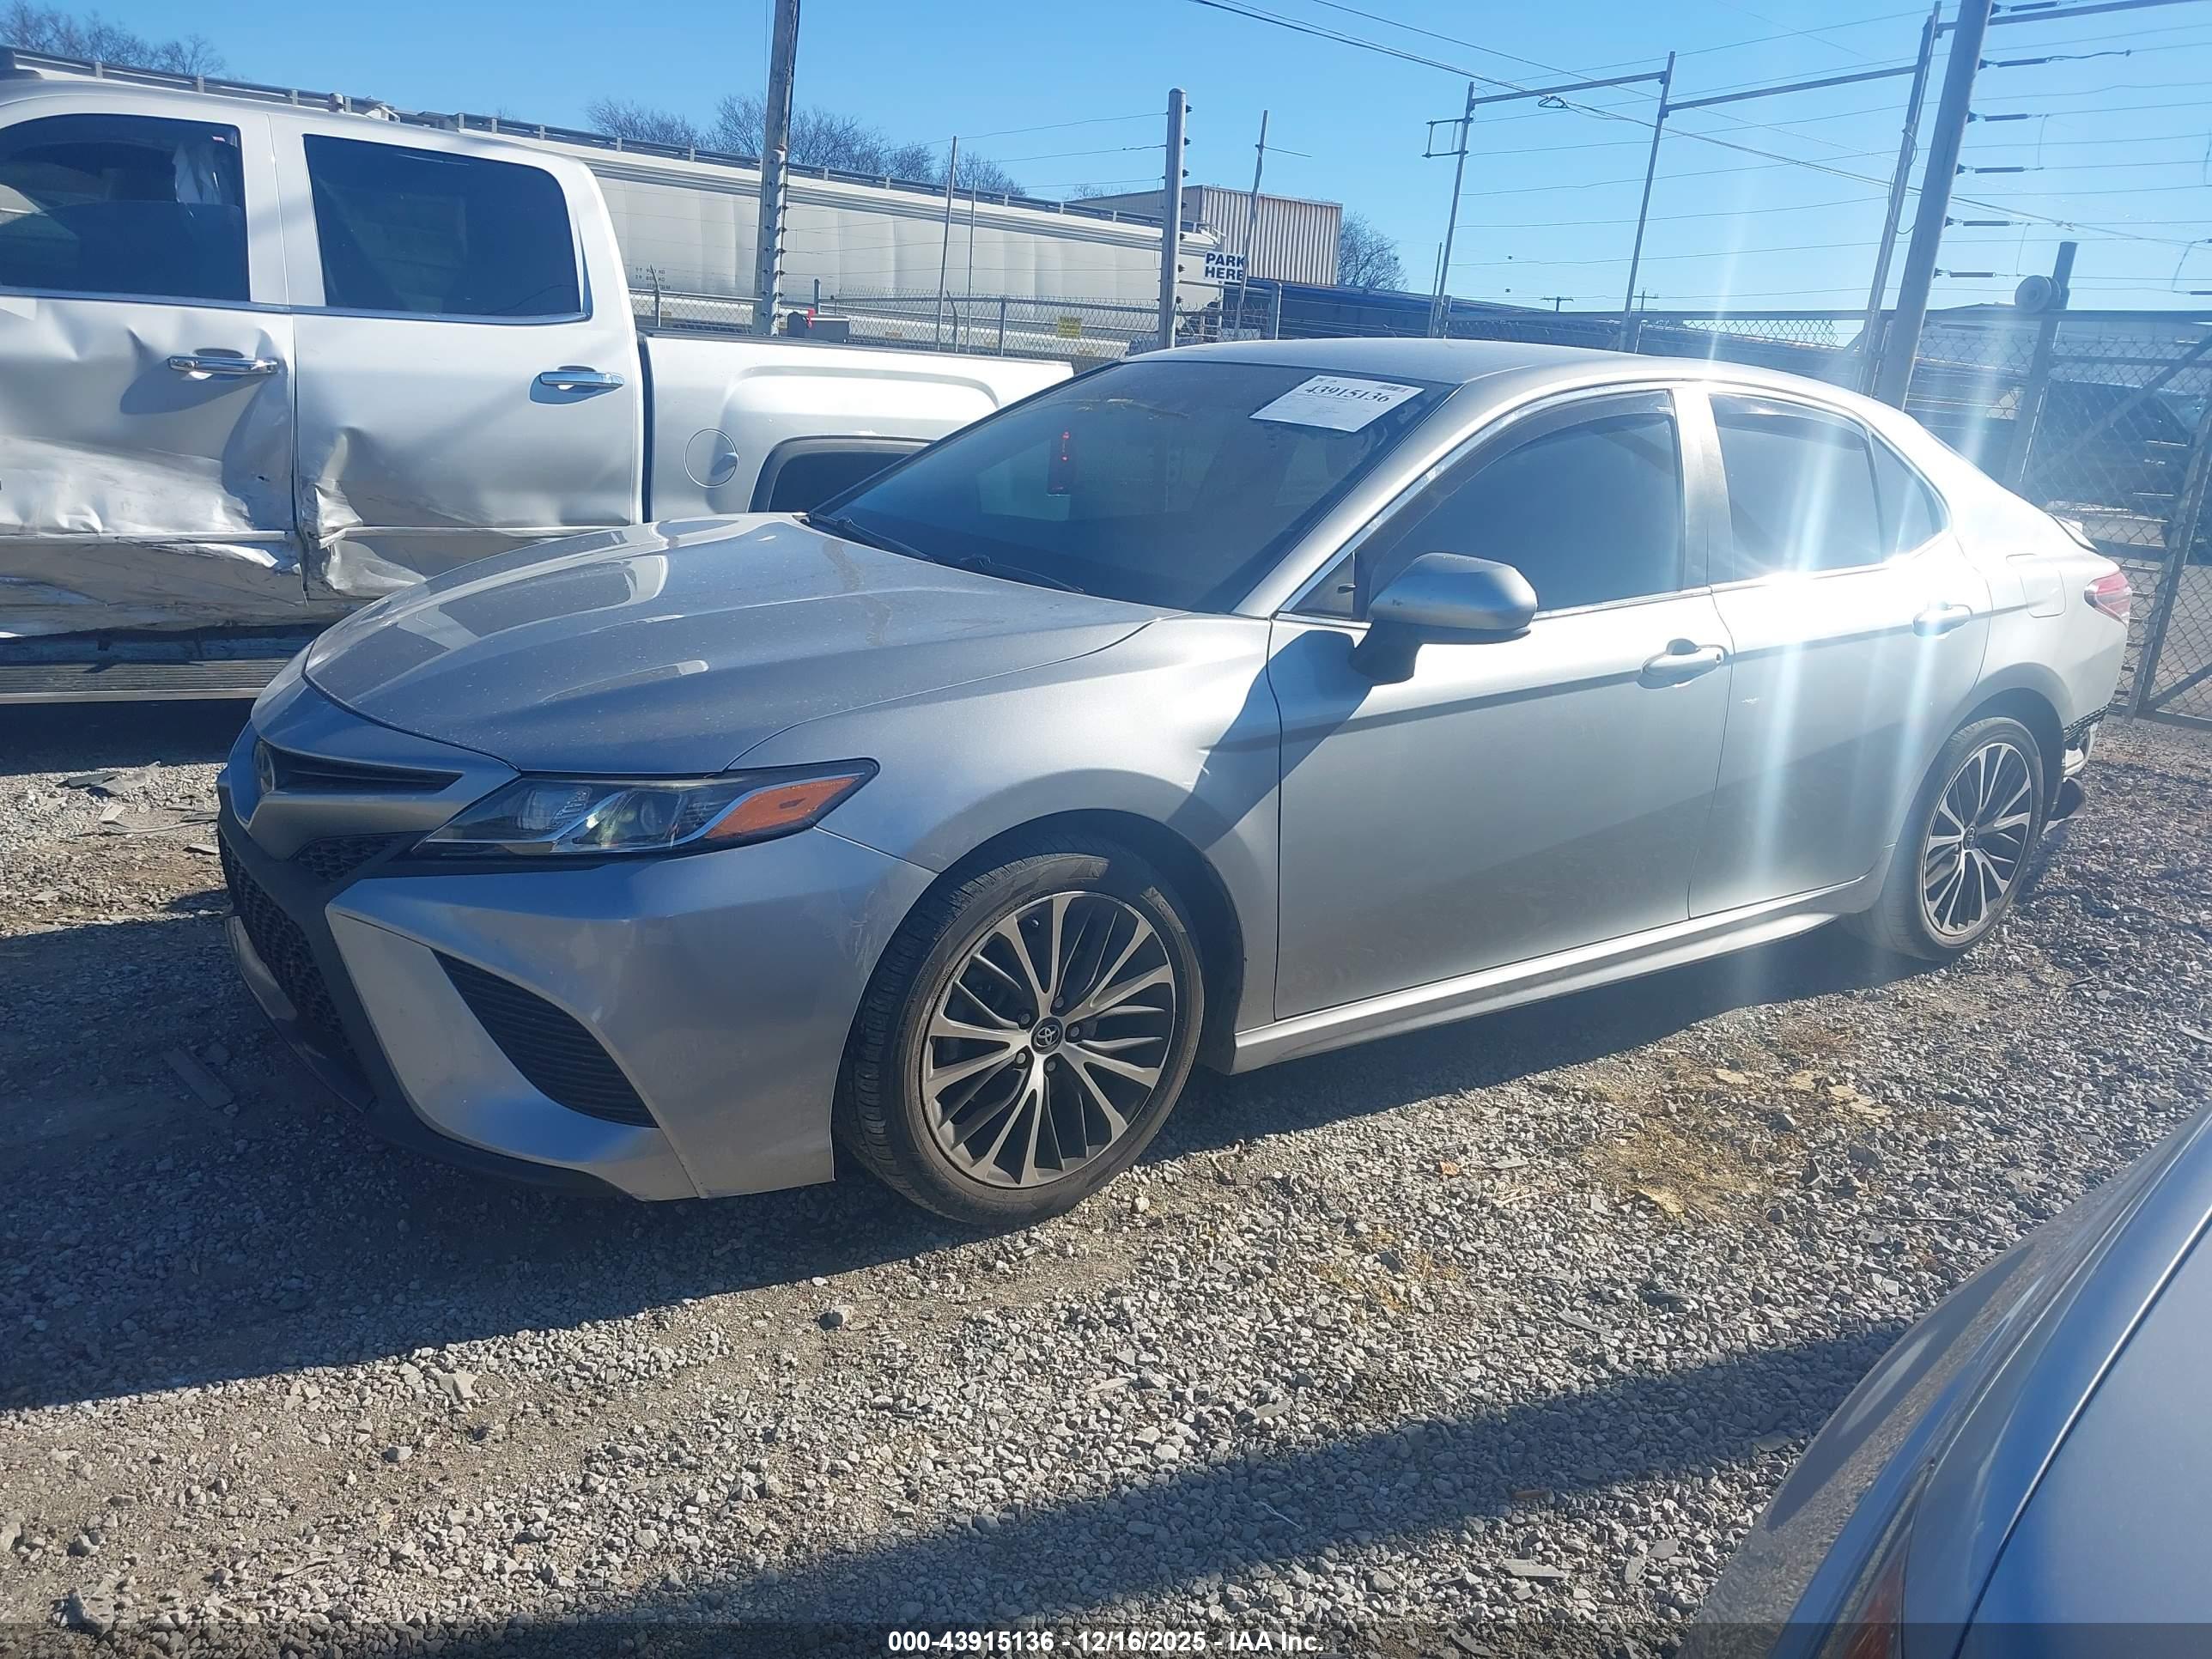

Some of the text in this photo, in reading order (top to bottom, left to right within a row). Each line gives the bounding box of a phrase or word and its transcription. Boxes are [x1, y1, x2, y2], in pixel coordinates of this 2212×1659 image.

[1206, 252, 1245, 267] PARK
[1205, 266, 1243, 281] HERE
[1305, 385, 1395, 403] 43915136
